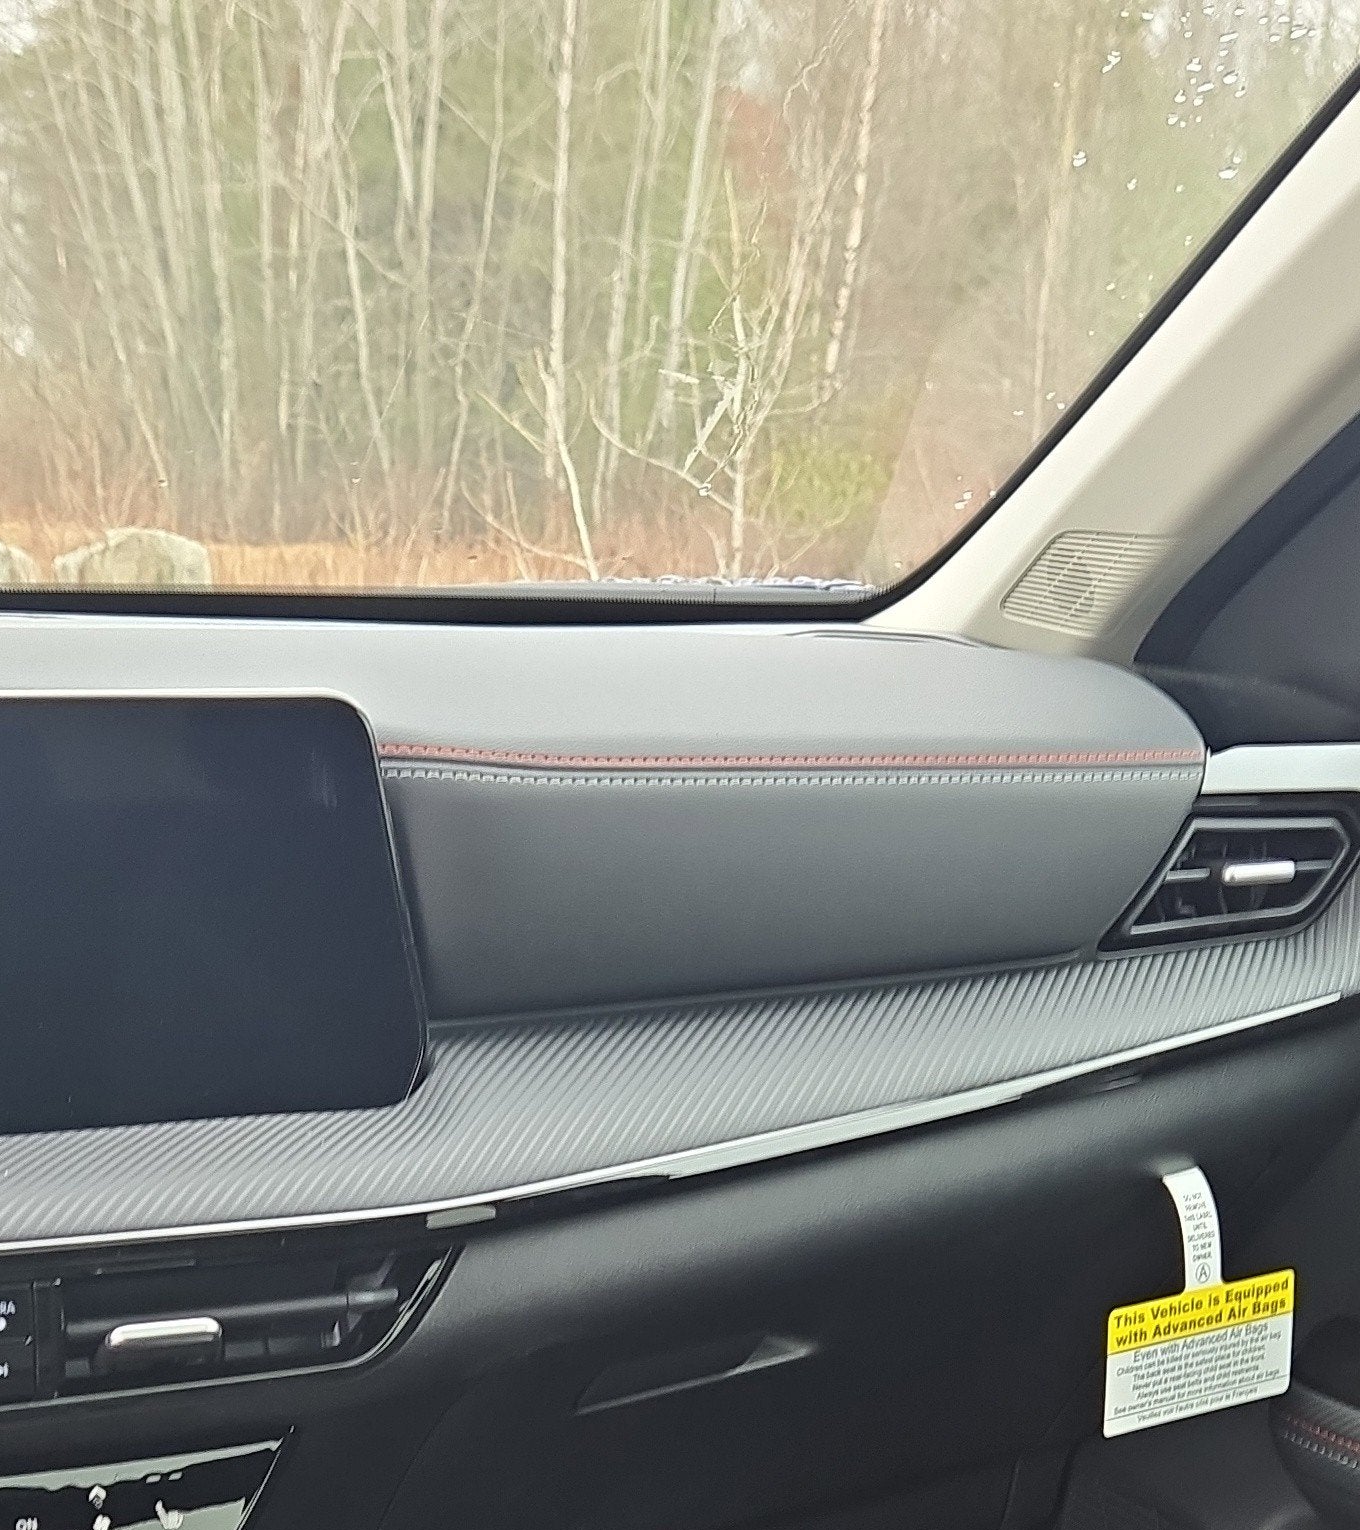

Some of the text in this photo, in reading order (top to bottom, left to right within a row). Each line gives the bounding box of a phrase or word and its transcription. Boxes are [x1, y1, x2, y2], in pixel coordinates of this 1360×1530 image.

[1114, 1277, 1289, 1329] This Vehicle is Equipped
[1116, 1299, 1285, 1347] with Advanced Air Bags
[1133, 1349, 1158, 1362] Even
[1181, 1329, 1228, 1351] Advanced
